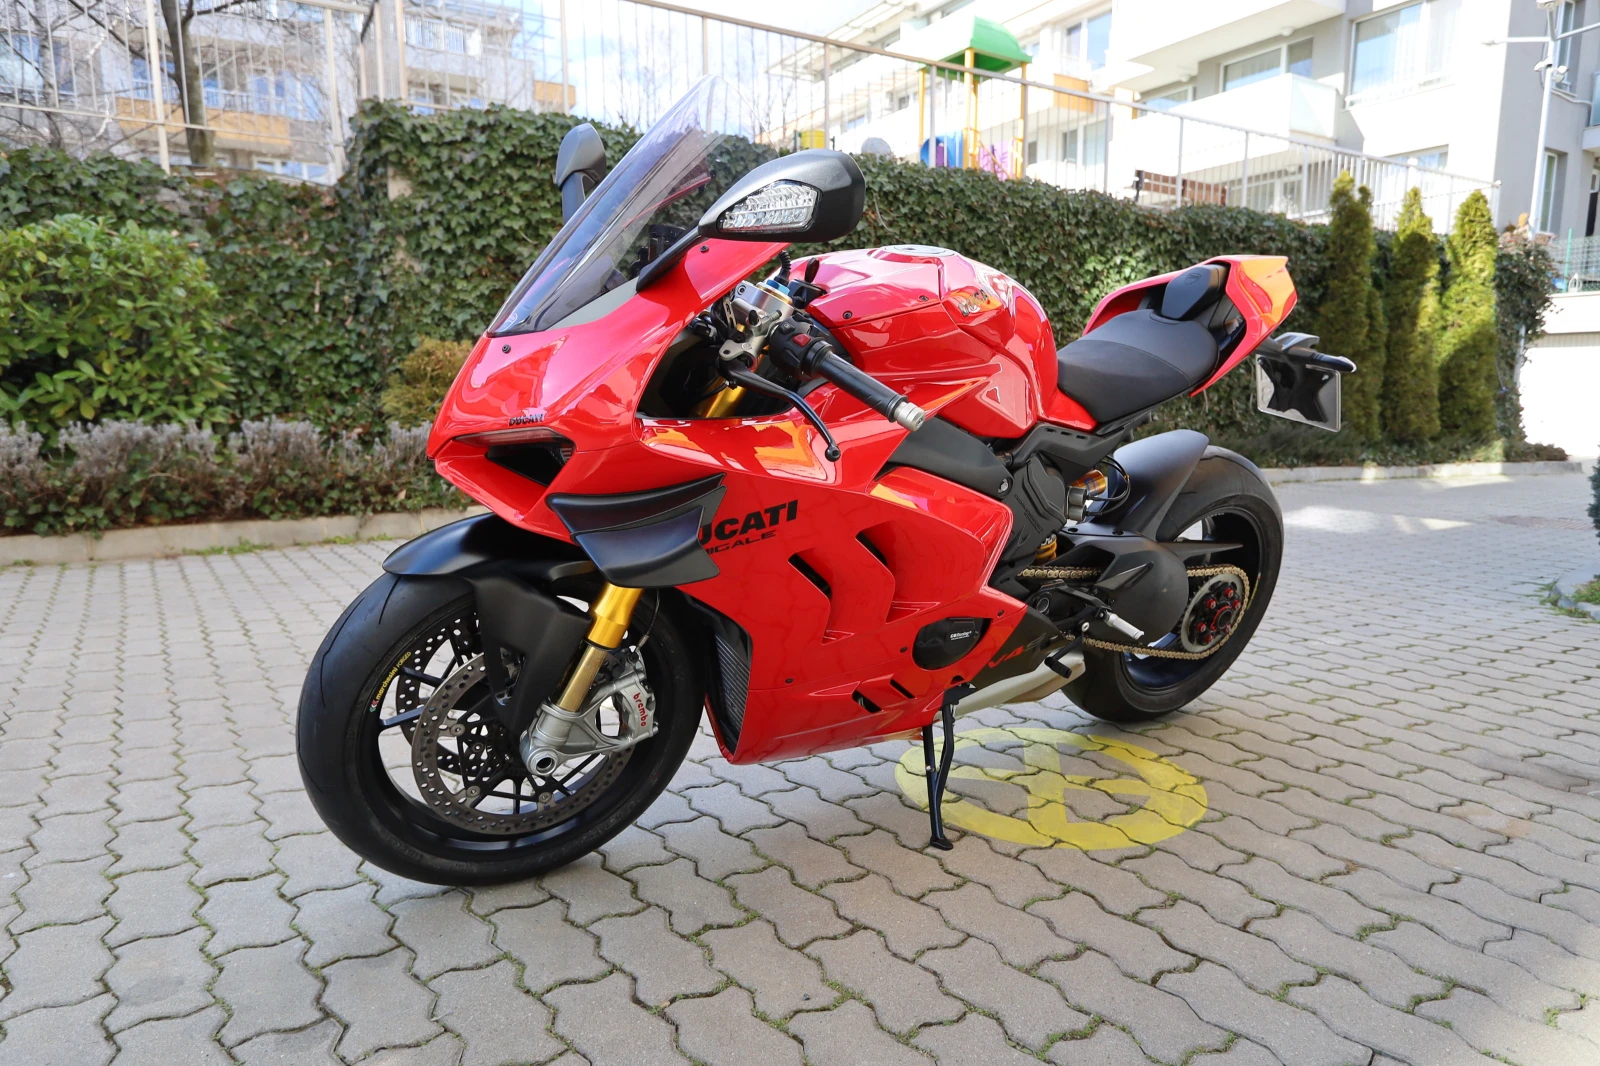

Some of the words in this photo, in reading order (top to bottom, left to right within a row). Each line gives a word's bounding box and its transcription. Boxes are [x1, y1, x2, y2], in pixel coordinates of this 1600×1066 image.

[508, 413, 543, 426] DUCATI
[697, 499, 799, 546] UCATI
[987, 645, 1024, 669] V4
[375, 666, 398, 700] marchesini
[633, 692, 648, 727] brembo
